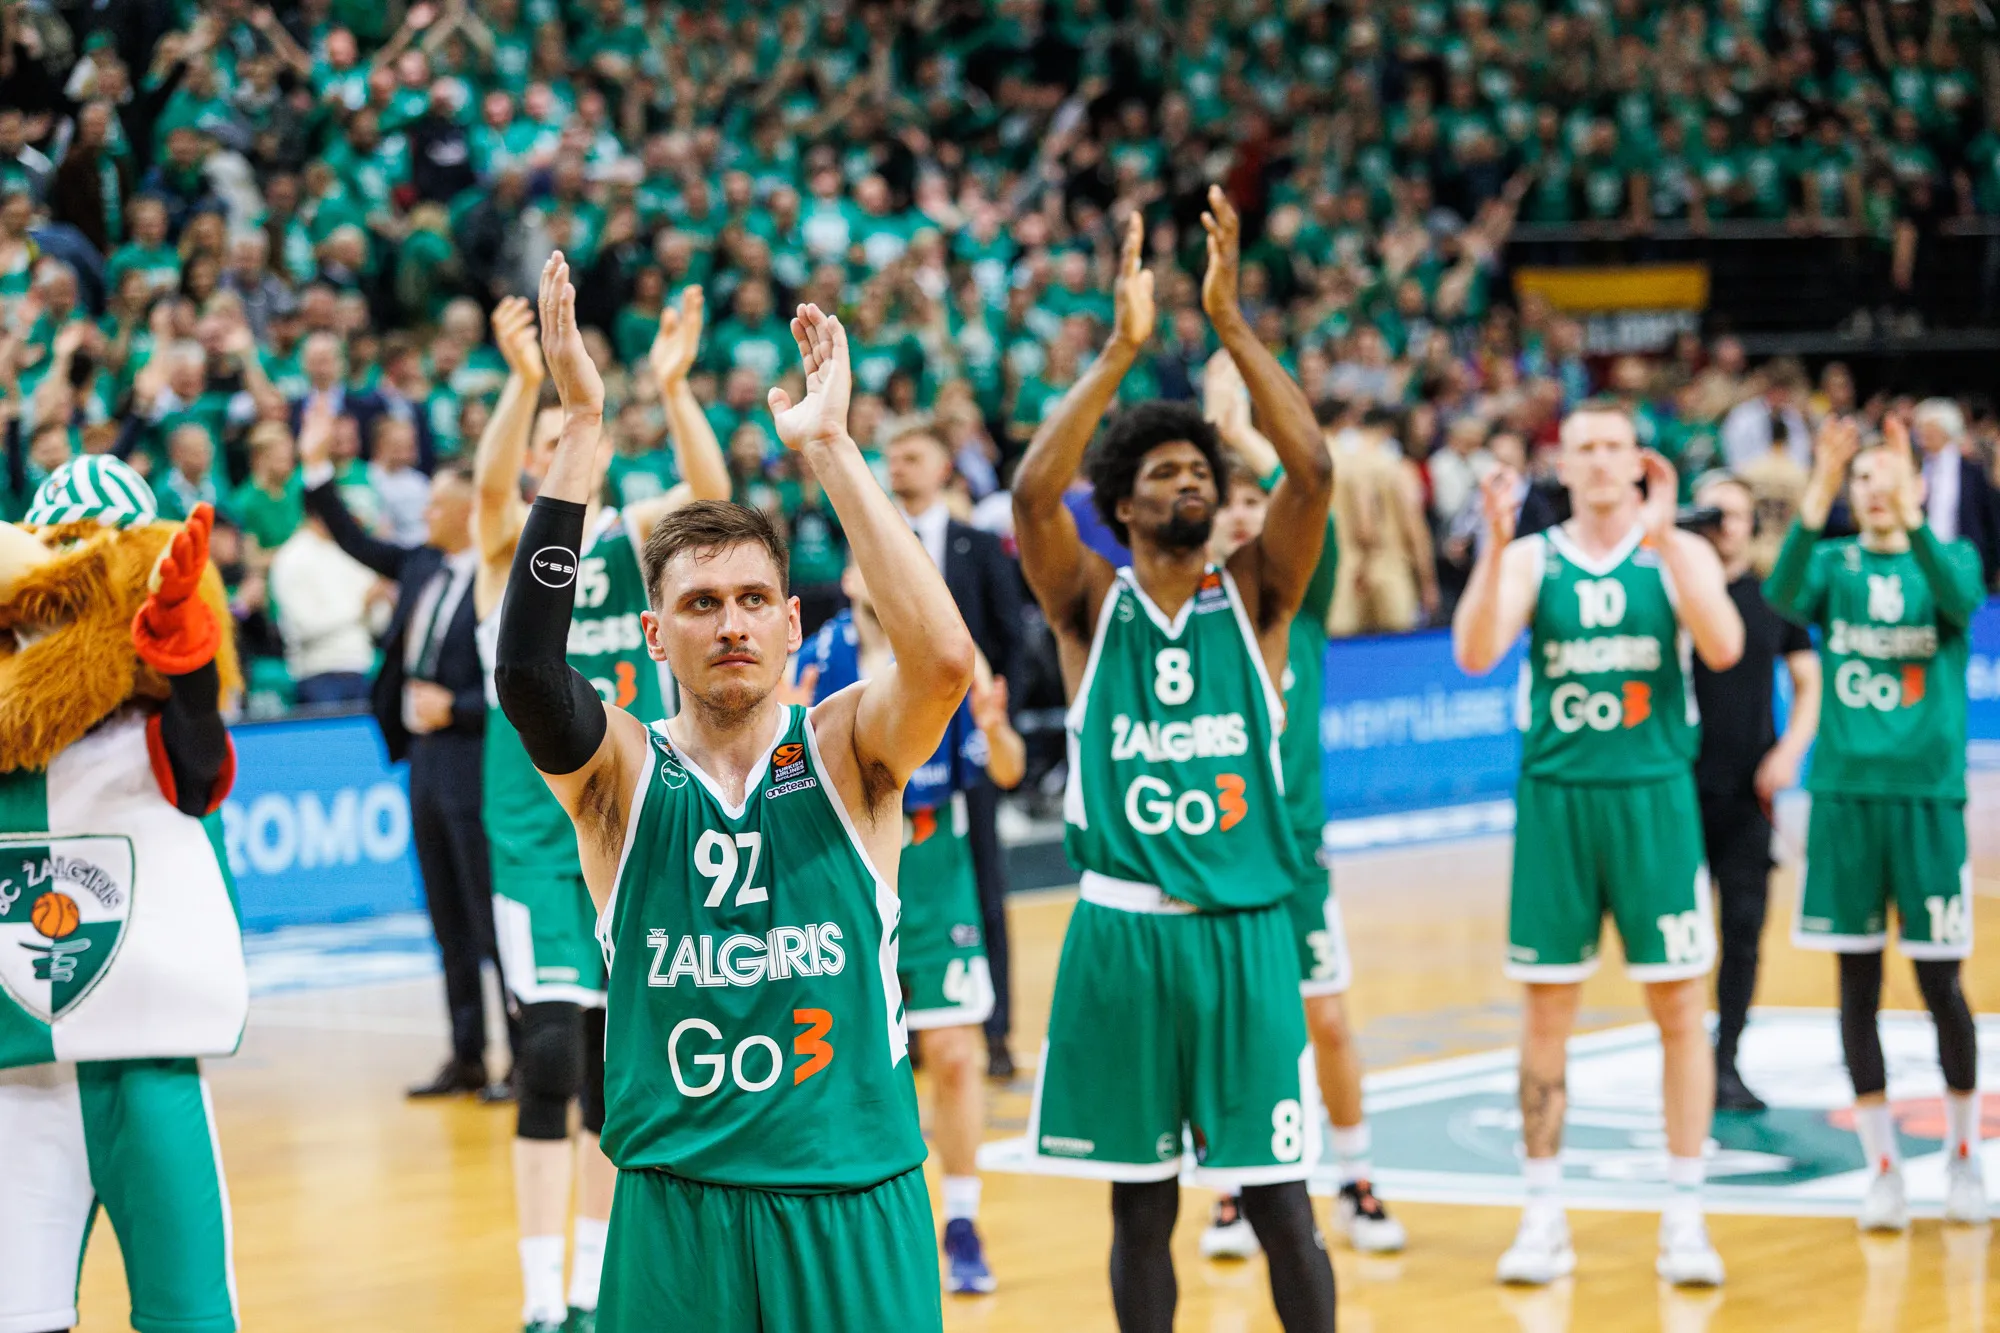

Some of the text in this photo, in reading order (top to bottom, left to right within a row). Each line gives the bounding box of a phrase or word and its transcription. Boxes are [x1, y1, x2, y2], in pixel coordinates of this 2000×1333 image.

[1573, 577, 1627, 629] 10
[1153, 647, 1194, 705] 8
[1550, 680, 1652, 733] Go3
[766, 778, 816, 798] oneteam
[775, 760, 804, 774] TURKISH
[1125, 773, 1248, 836] Go3
[694, 828, 769, 908] 92
[647, 921, 846, 988] ŽALGIRIS
[1657, 910, 1704, 963] 10
[667, 1007, 834, 1098] Go3
[1271, 1099, 1302, 1163] 8
